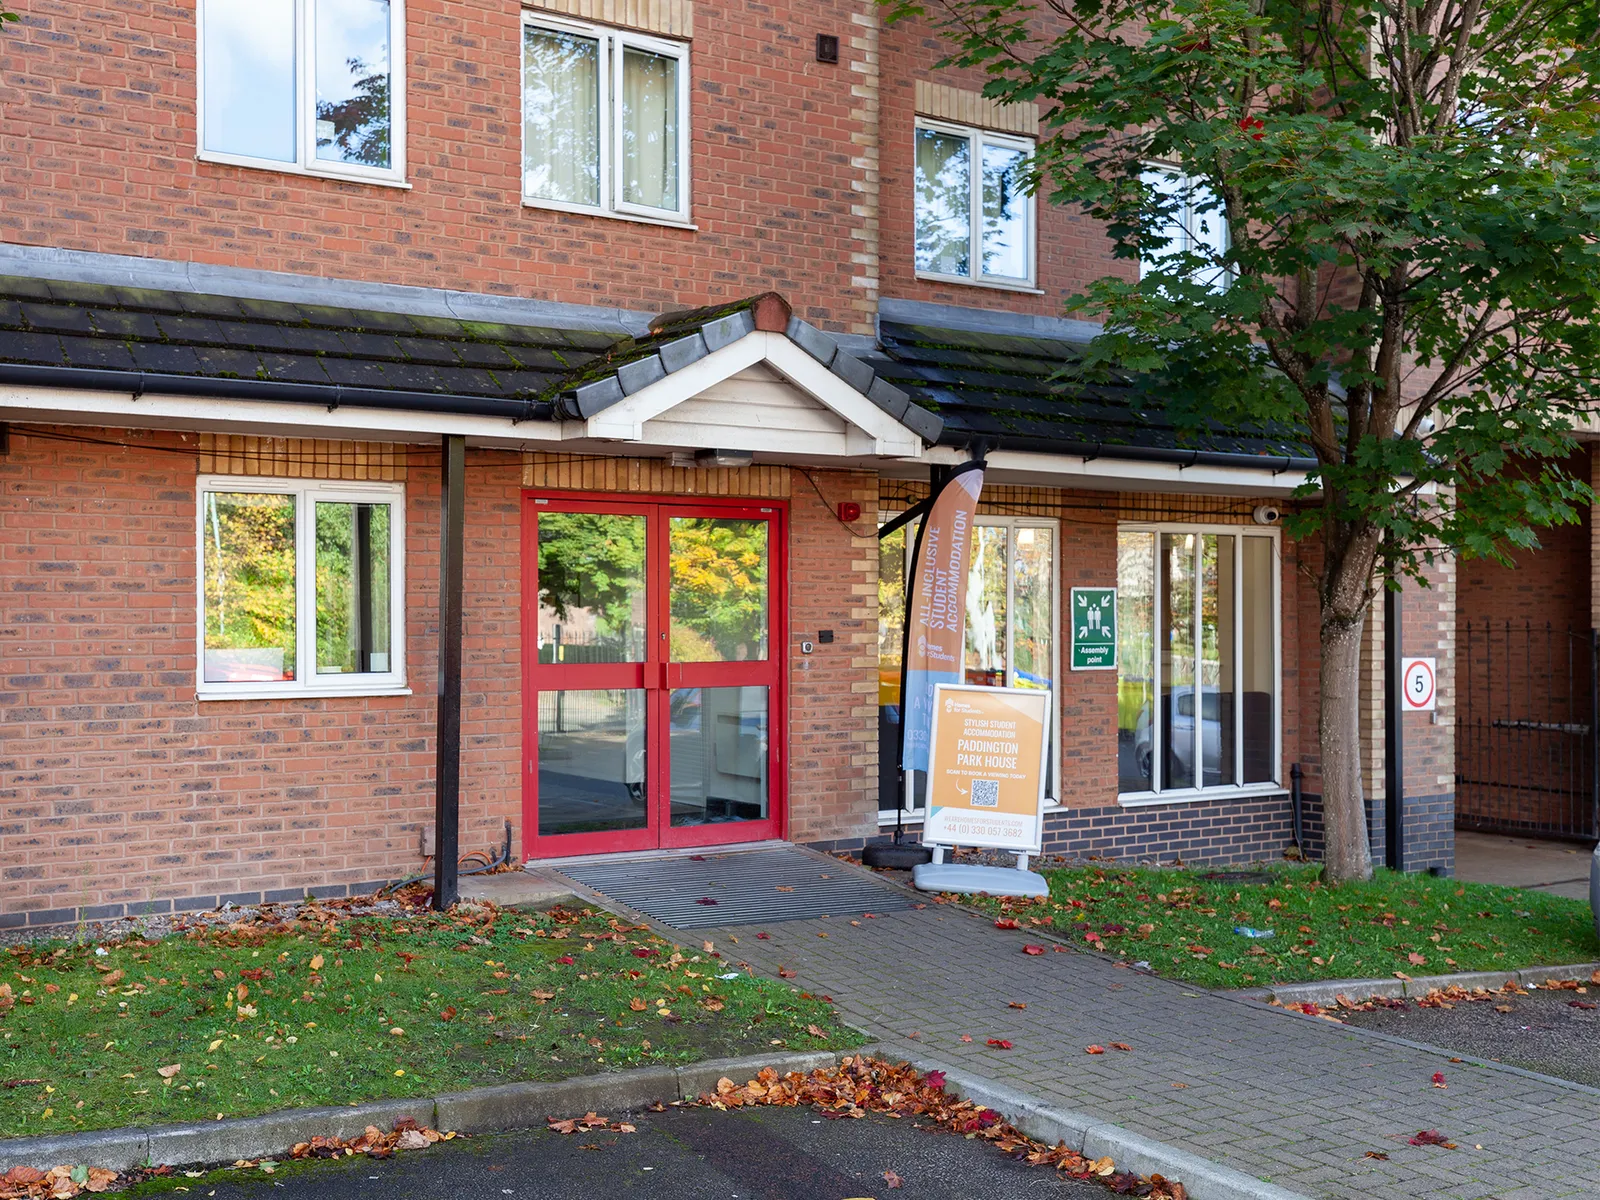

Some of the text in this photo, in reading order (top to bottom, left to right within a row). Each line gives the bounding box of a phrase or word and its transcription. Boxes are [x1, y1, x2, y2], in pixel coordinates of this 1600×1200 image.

[920, 526, 940, 627] ALL-INCLUSIVE
[947, 510, 967, 632] ACCOMMODATION
[930, 568, 947, 629] STUDENT
[1081, 646, 1109, 655] Assembly
[1087, 656, 1102, 664] point
[1415, 675, 1424, 693] 5
[964, 719, 1016, 729] STYLISH STUDENT
[963, 728, 1016, 738] ACCOMMODATION
[958, 739, 1018, 754] PADDINGTON
[957, 754, 1017, 769] PARK HOUSE
[943, 824, 1022, 838] +44 (0) 330 057 3682
